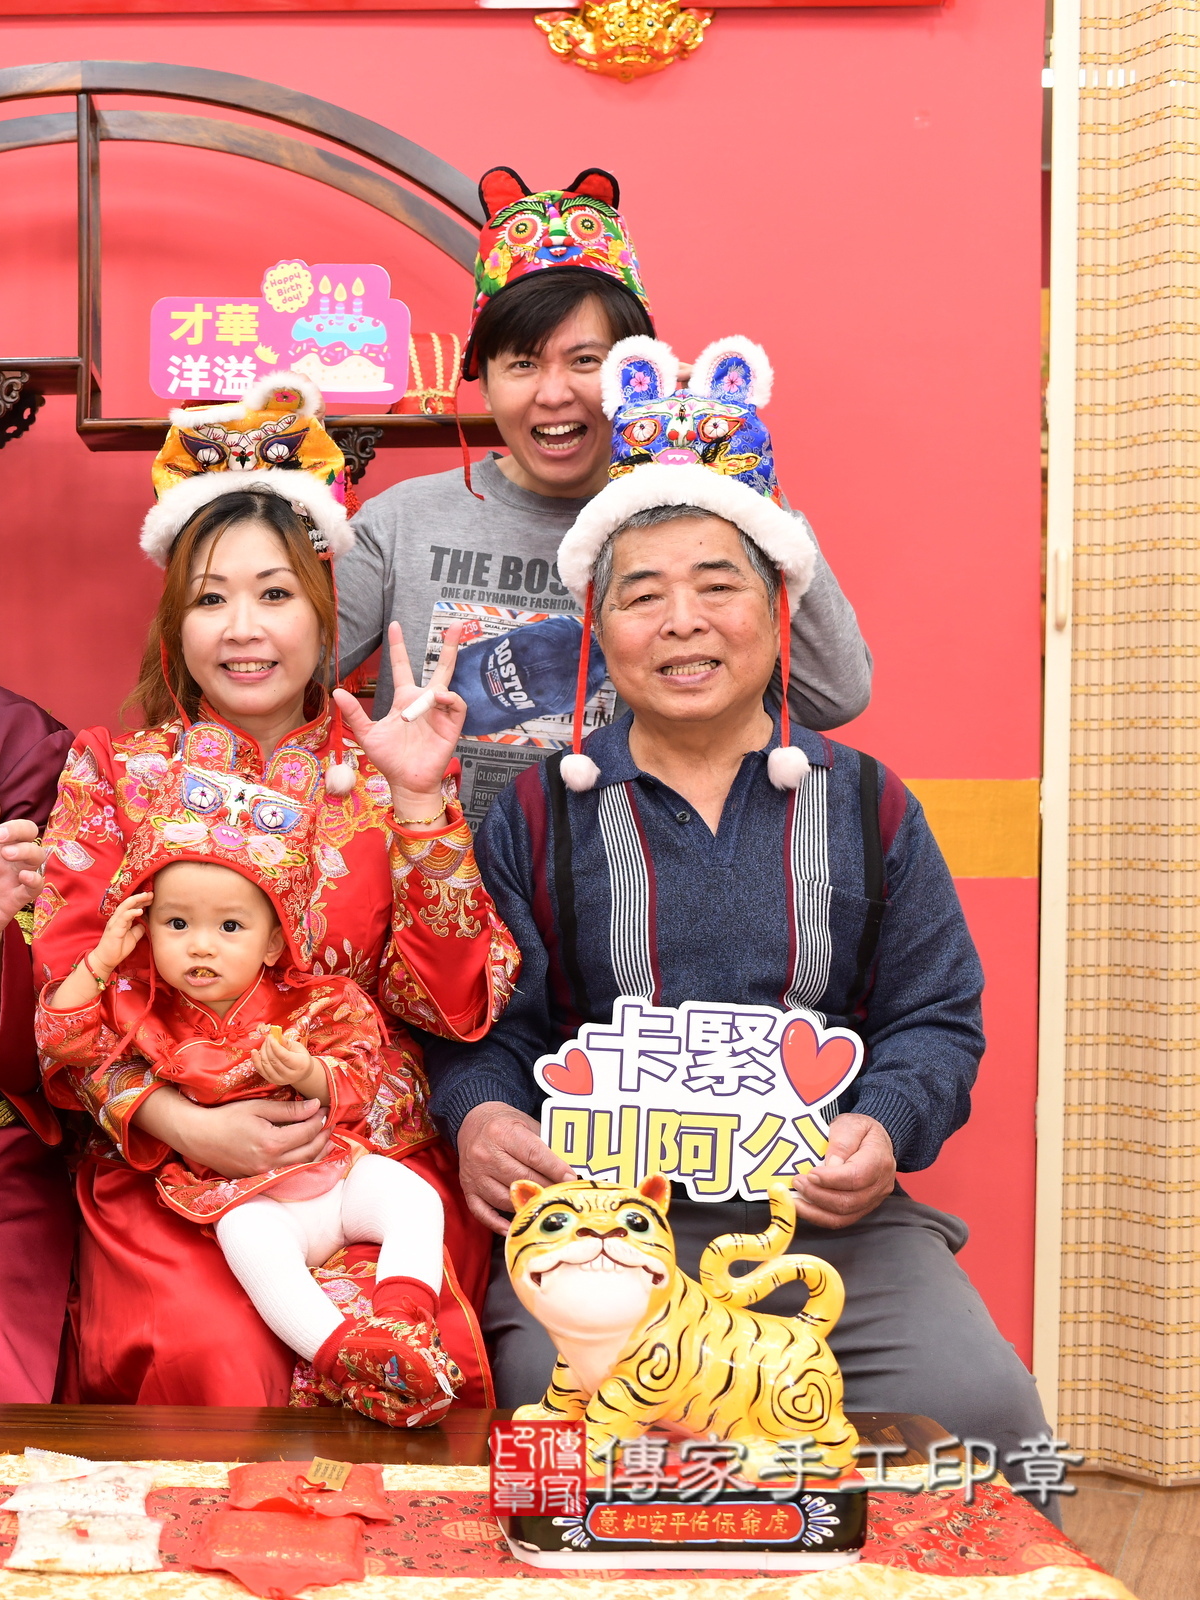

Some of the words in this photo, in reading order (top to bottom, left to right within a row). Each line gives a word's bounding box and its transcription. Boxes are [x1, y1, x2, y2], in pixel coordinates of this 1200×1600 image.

[270, 272, 301, 287] Happy
[277, 283, 302, 297] Birth
[282, 290, 303, 304] day!
[169, 303, 259, 346] 才華
[167, 354, 257, 396] 洋溢
[430, 545, 492, 588] THE
[441, 586, 461, 599] ONE
[462, 589, 476, 601] OF
[529, 596, 577, 611] FASHION
[493, 638, 536, 710] BOSTON
[455, 744, 479, 755] BROWN
[479, 747, 508, 759] SEASONS
[508, 750, 525, 760] WITH
[477, 770, 506, 783] CLOSED
[475, 791, 498, 801] ROO
[586, 1004, 780, 1096] 卡緊
[549, 1104, 830, 1195] 叫阿公
